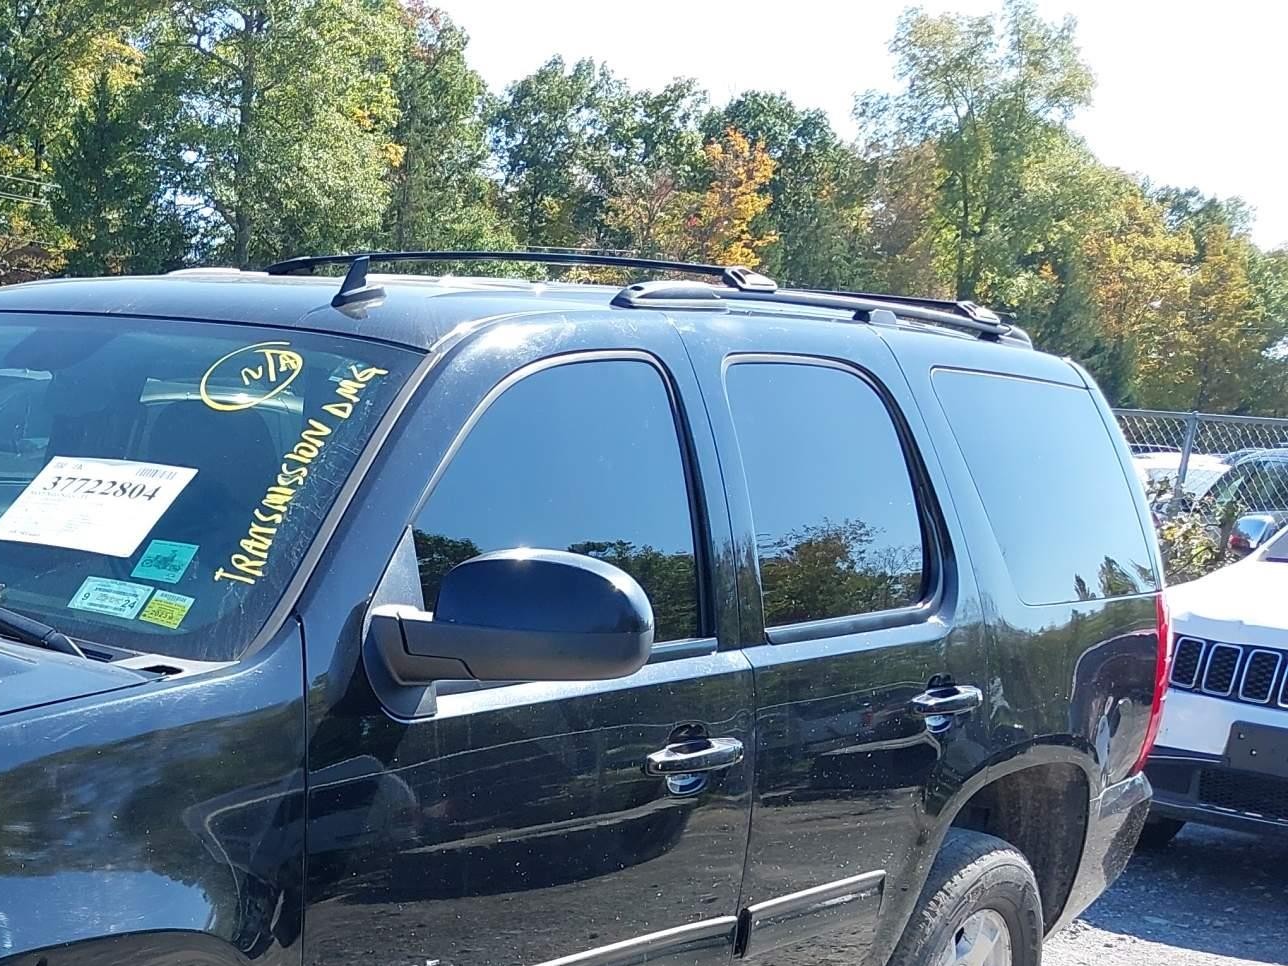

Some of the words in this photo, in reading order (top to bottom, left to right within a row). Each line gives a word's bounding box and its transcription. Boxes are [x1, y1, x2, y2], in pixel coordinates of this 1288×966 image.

[214, 419, 332, 584] TRANSMISSION
[322, 365, 389, 419] DMG
[42, 476, 162, 501] 37722804
[82, 593, 90, 601] 9
[120, 600, 136, 609] 24
